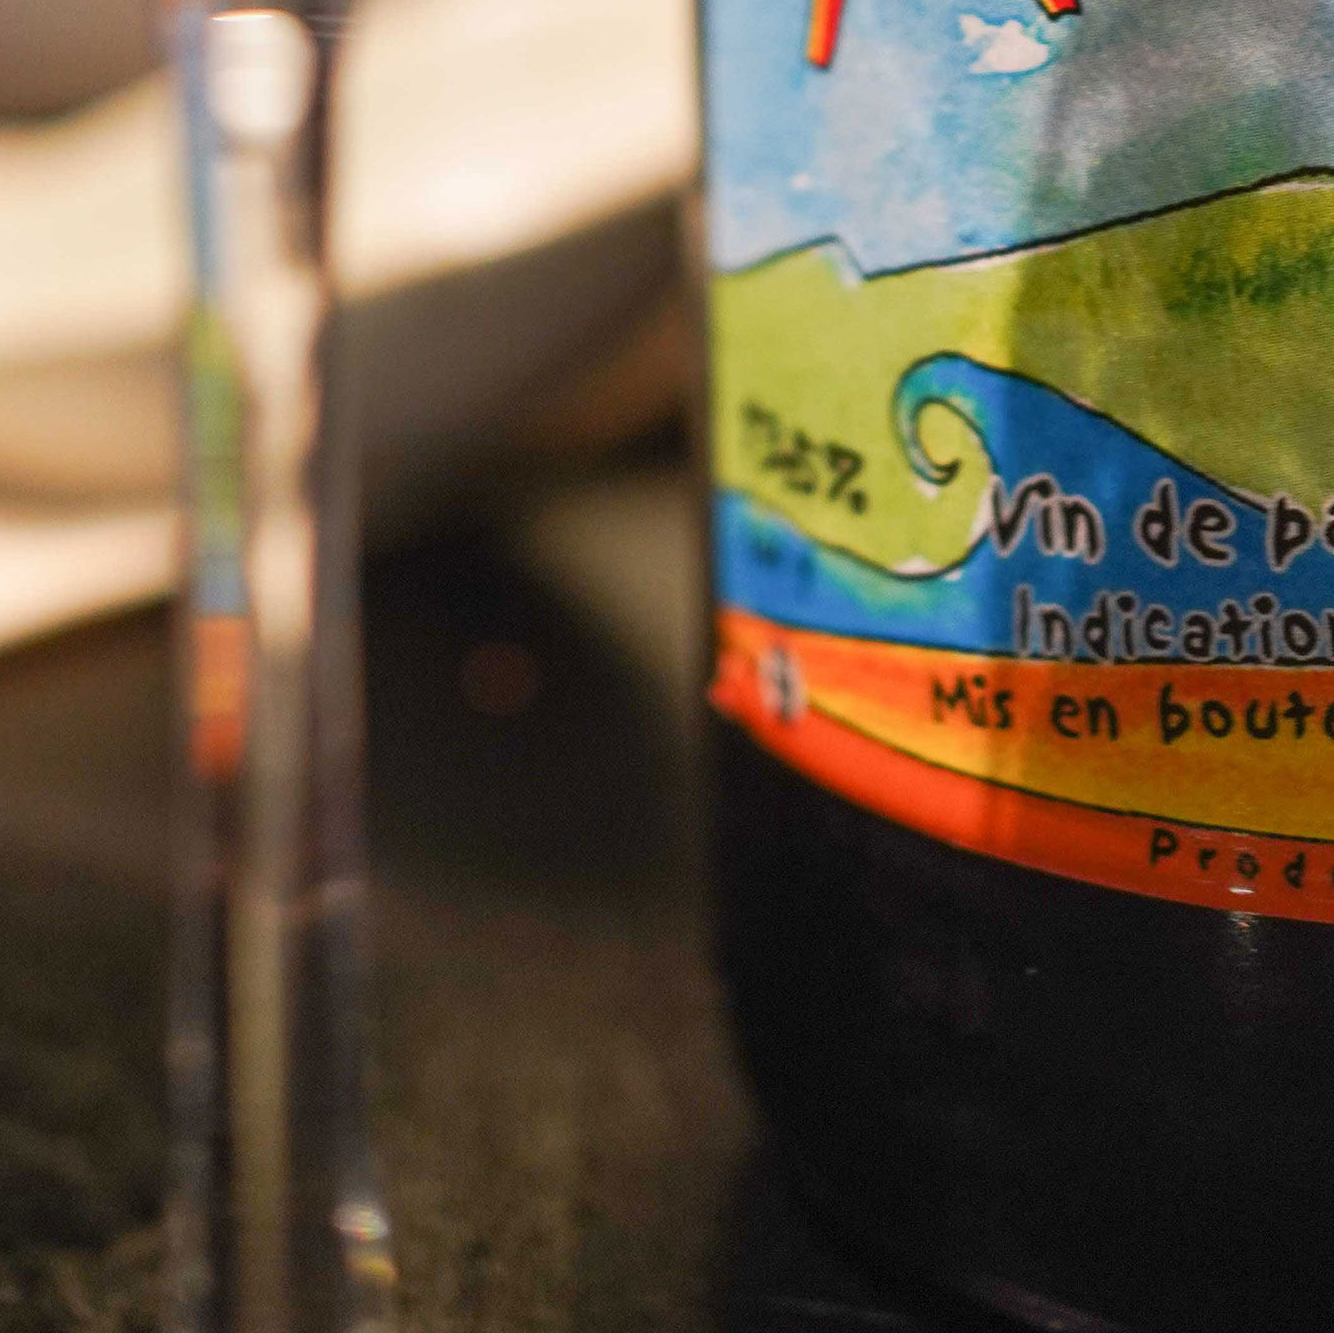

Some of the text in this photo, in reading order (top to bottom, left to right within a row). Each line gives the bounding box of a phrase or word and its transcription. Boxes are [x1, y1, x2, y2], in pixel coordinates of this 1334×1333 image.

[1137, 479, 1233, 565] de
[930, 673, 1014, 729] Mis
[1049, 694, 1120, 741] en
